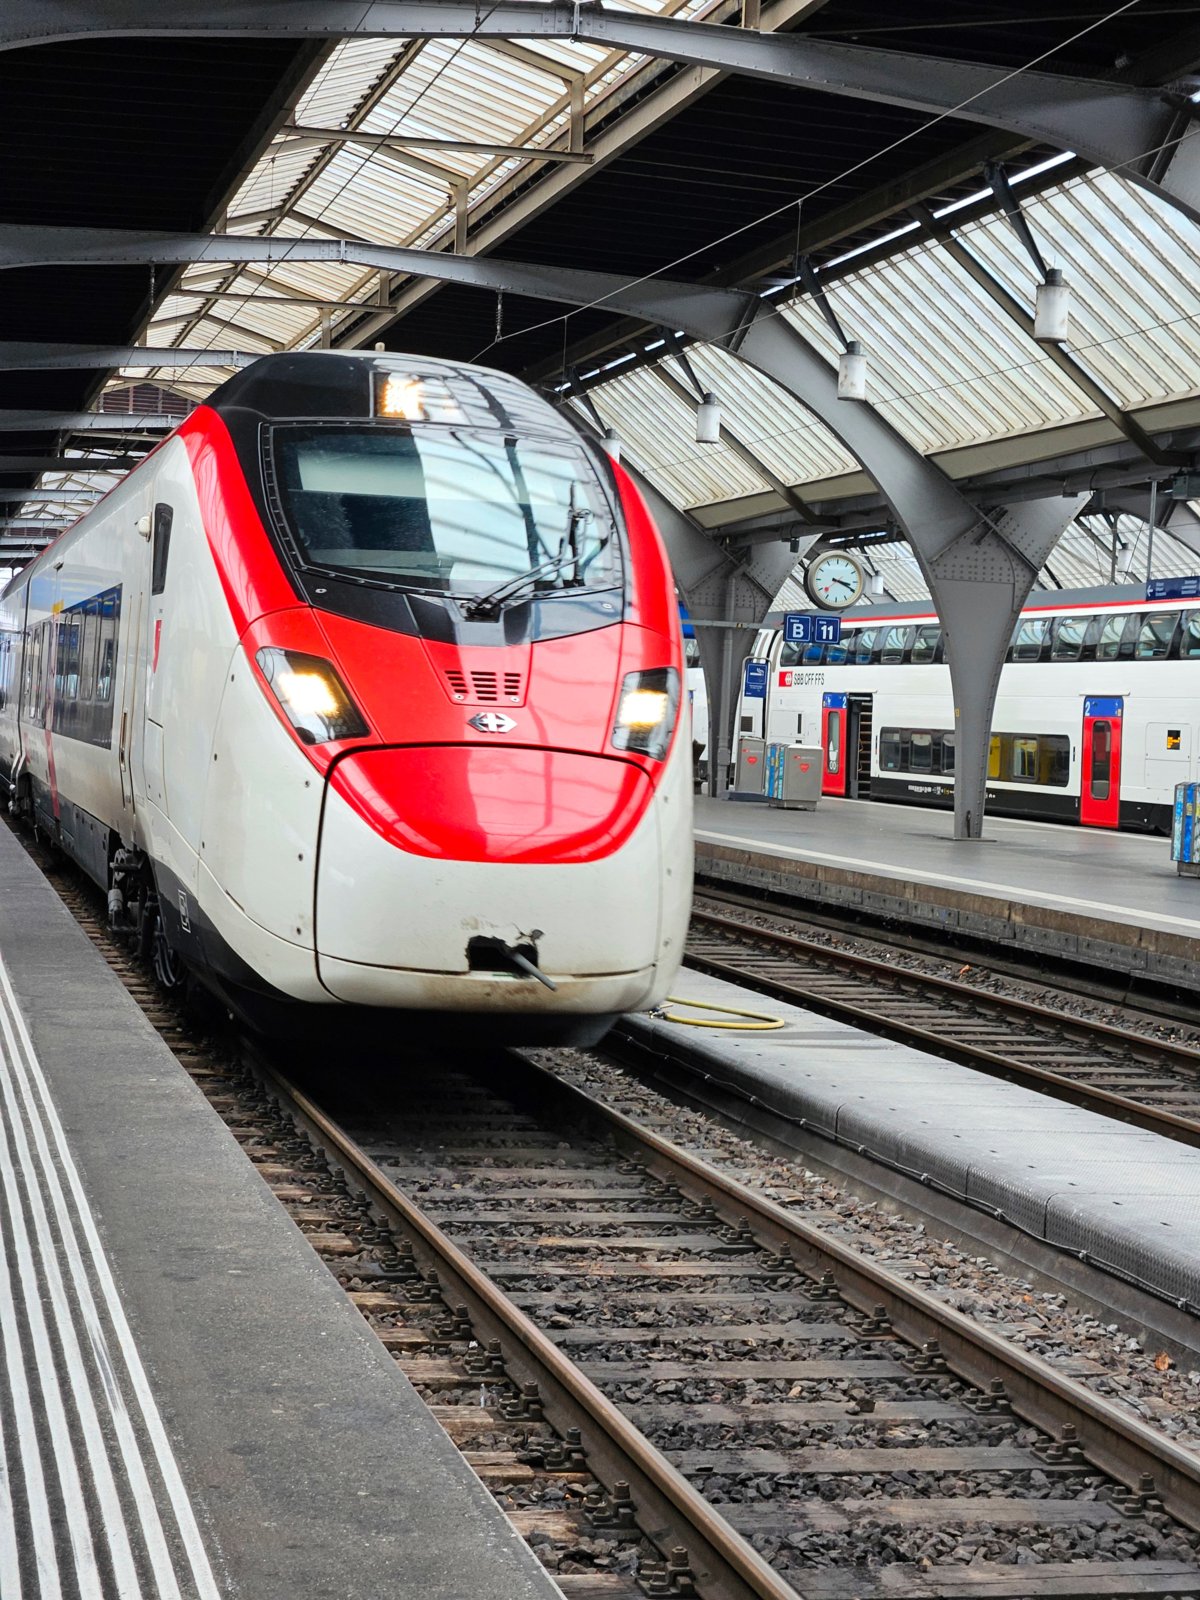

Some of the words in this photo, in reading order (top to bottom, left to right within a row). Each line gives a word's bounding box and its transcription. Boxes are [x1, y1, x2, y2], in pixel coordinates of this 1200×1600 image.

[792, 624, 803, 638] B
[821, 625, 833, 640] 11
[794, 673, 804, 685] SBB
[804, 673, 814, 685] CFF
[815, 673, 825, 685] FFS
[842, 696, 847, 708] 2
[1085, 701, 1090, 716] 2
